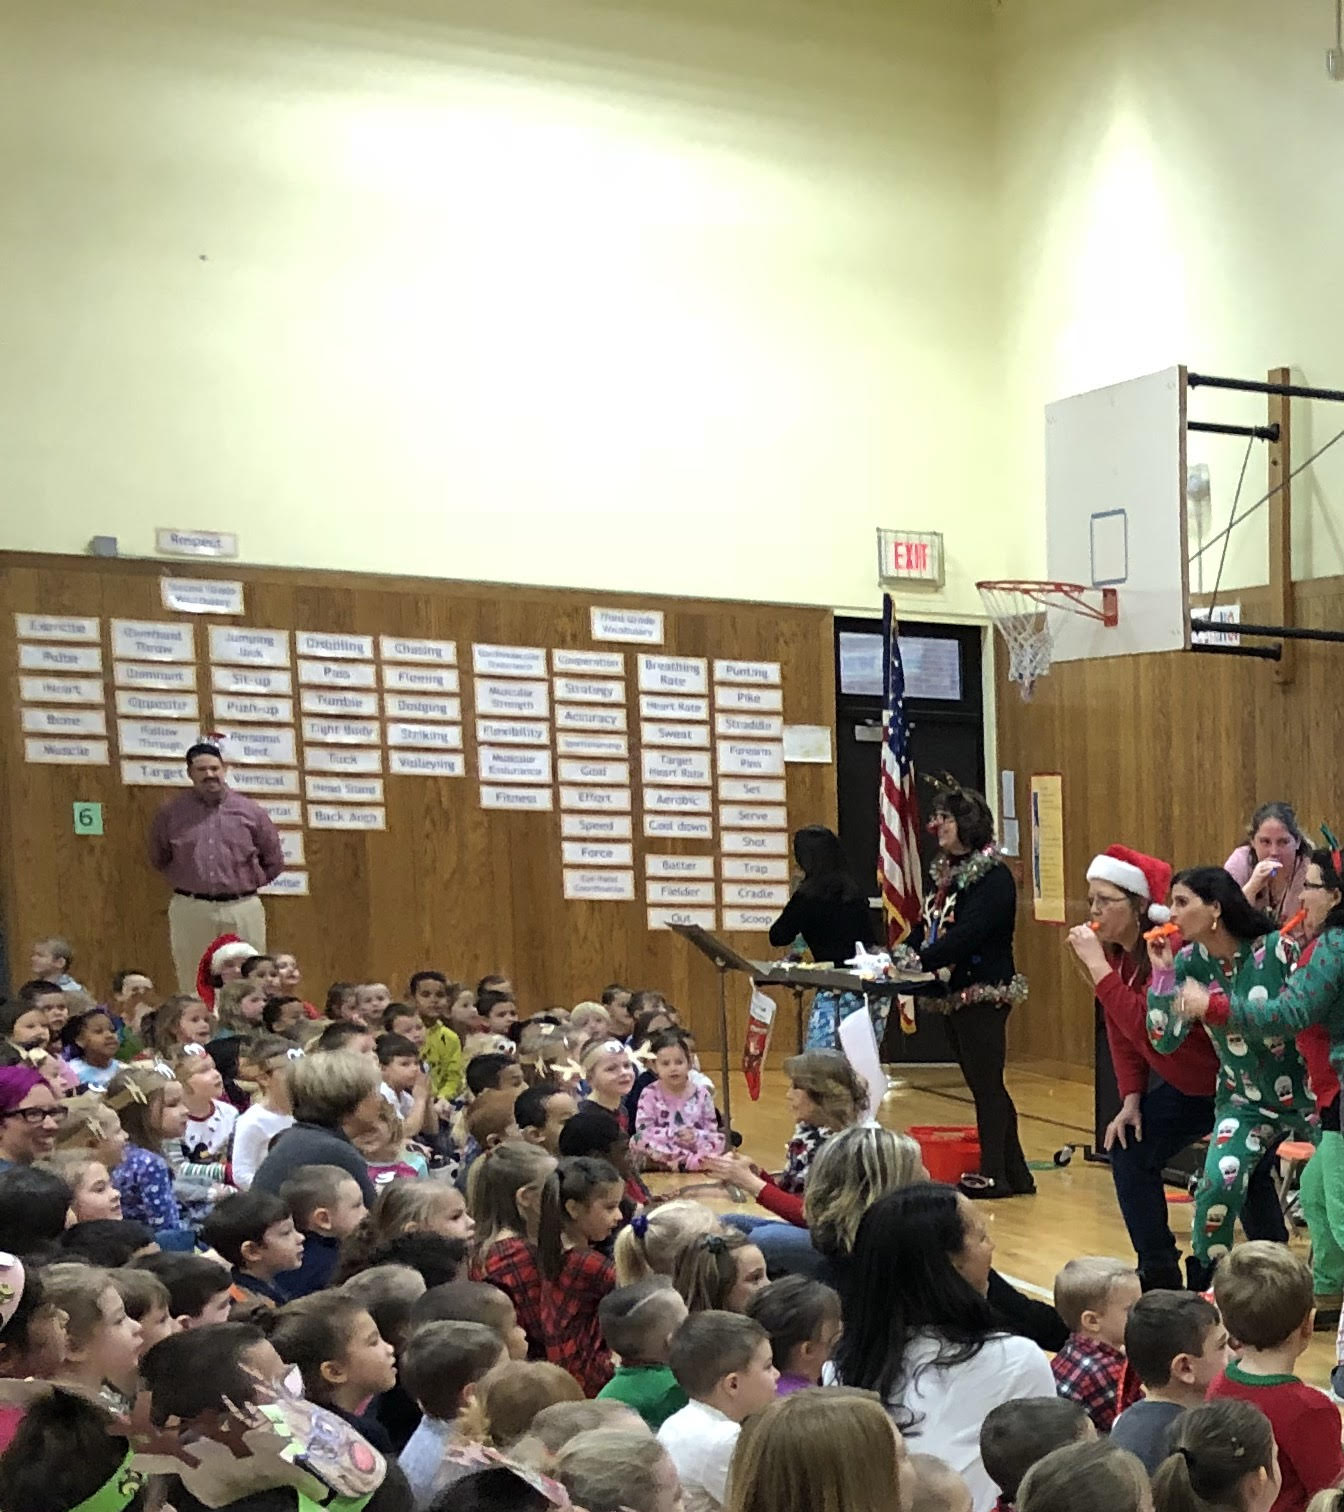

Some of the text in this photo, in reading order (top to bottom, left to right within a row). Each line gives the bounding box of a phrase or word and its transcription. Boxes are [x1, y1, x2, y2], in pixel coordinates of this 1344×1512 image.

[894, 542, 927, 570] EXIT
[226, 633, 275, 648] Jumping
[395, 643, 442, 659] Chasing
[645, 659, 701, 676] Breathing
[726, 664, 769, 680] Punting
[232, 673, 272, 688] Sit-up
[660, 675, 687, 688] Rate
[564, 682, 614, 698] Strategy
[737, 692, 762, 704] Pike
[226, 702, 280, 717] Push-up
[646, 700, 702, 714] Heart Rate
[564, 710, 618, 726] Accuracy
[401, 728, 449, 744] Striking
[483, 725, 543, 740] Flexibility
[657, 727, 693, 740] Sweat
[661, 755, 693, 768] Target
[140, 764, 185, 780] Target
[580, 766, 607, 778] Goal
[648, 767, 677, 779] Heart
[743, 783, 761, 795] Set
[495, 791, 537, 804] Fitness
[578, 791, 612, 803] Effort
[656, 794, 700, 806] Aerobic
[79, 808, 93, 827] 6
[315, 810, 345, 823] Back
[738, 810, 769, 821] Serve
[578, 819, 614, 833] Speed
[649, 819, 708, 833] Cool down
[742, 836, 767, 848] Shot
[581, 847, 614, 858] Force
[662, 860, 697, 871] Batter
[743, 863, 769, 875] Trap
[660, 886, 701, 897] Fielder
[737, 887, 774, 899] Cradle
[671, 913, 692, 923] Out
[740, 913, 773, 926] Scoop
